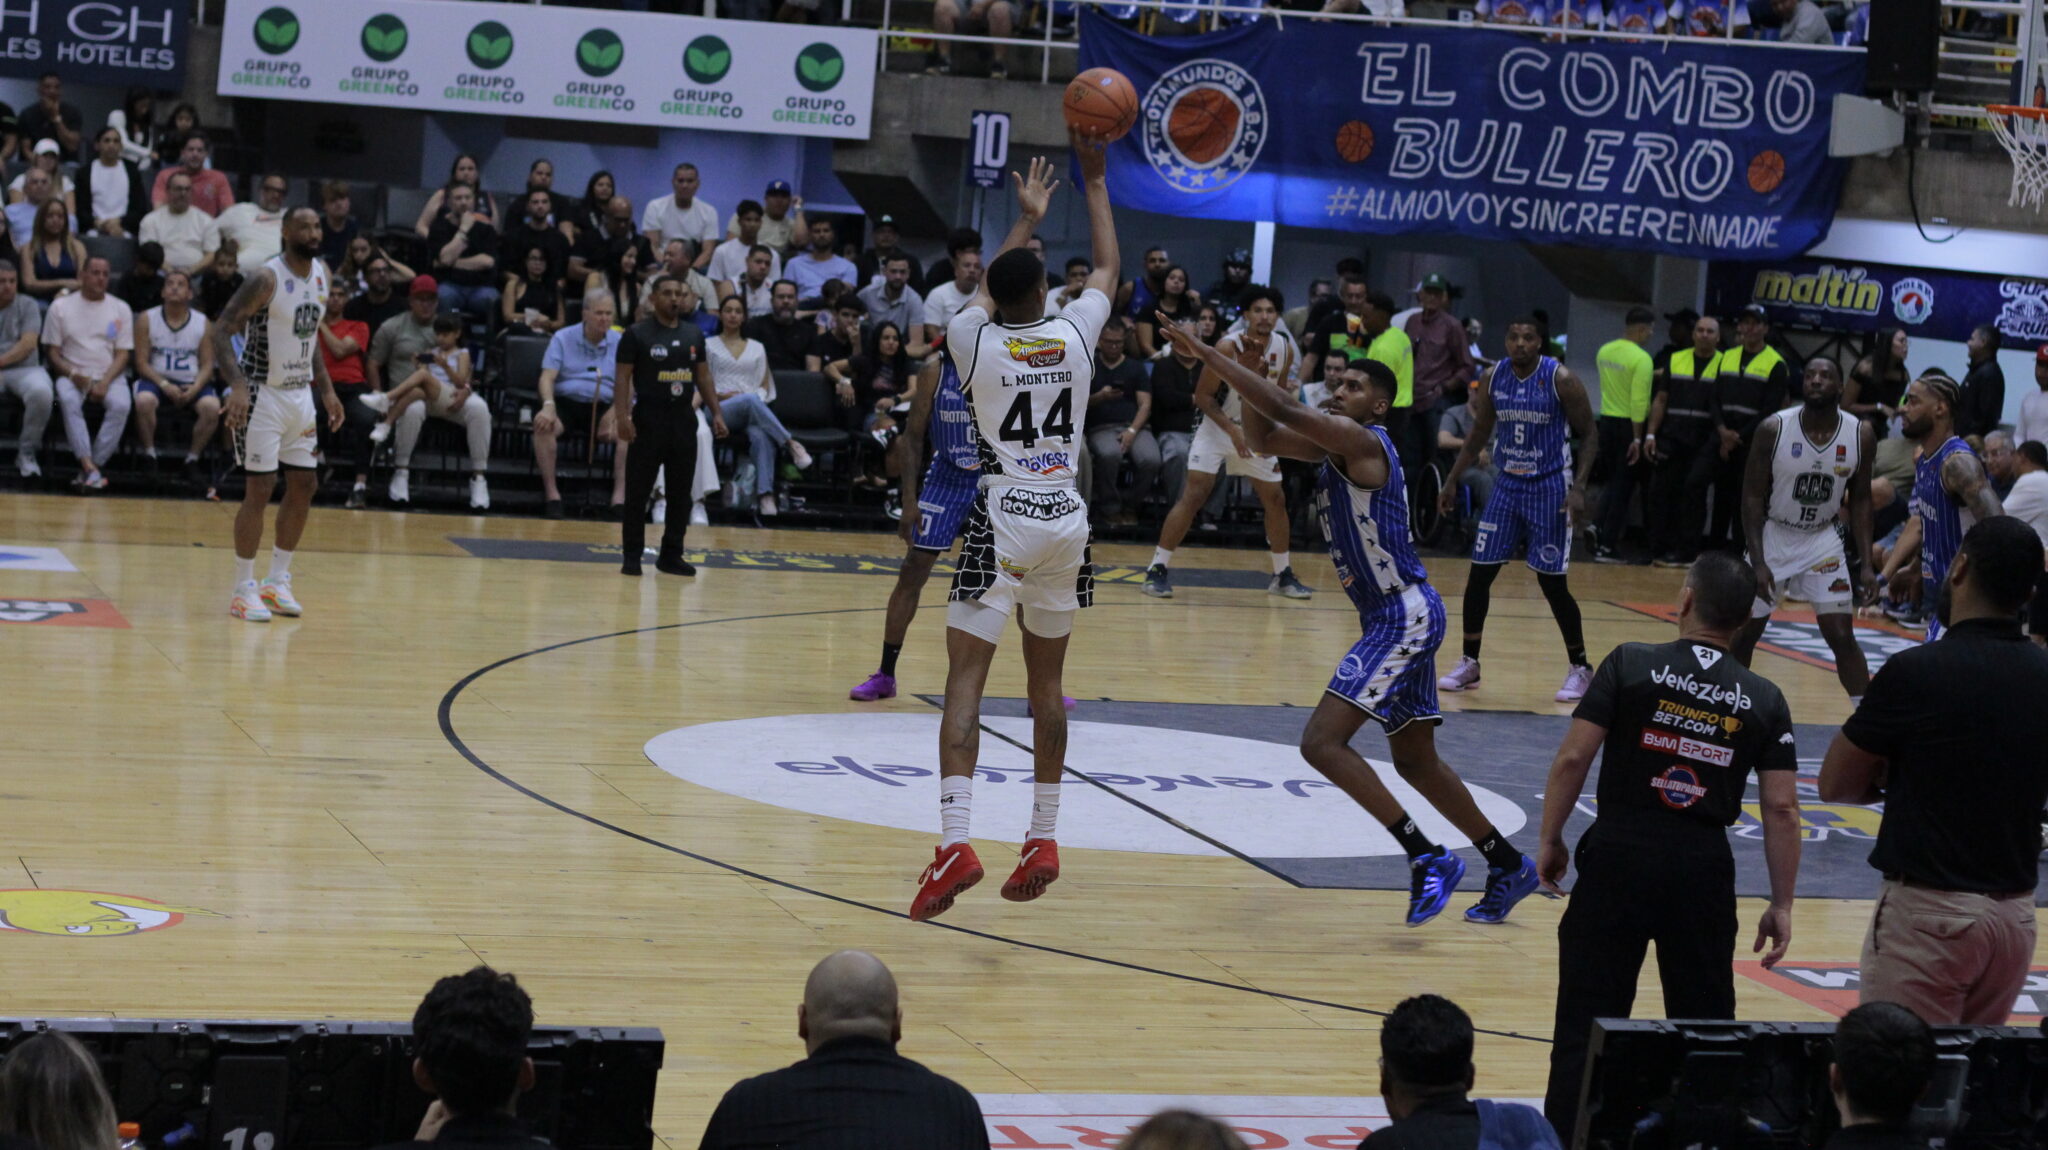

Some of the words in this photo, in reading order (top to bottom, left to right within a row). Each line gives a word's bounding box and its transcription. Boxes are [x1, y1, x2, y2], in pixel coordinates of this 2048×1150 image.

[67, 2, 173, 45] GH
[57, 42, 175, 71] HOTELES
[244, 59, 301, 74] GRUPO
[351, 66, 409, 82] GRUPO
[231, 72, 311, 89] GREENCO
[338, 79, 419, 96] GREENCO
[456, 74, 515, 89] GRUPO
[566, 82, 625, 96] GRUPO
[1357, 42, 1456, 106] EL
[1499, 46, 1815, 135] COMBO
[443, 87, 524, 104] GREENCO
[553, 94, 635, 111] GREENCO
[673, 88, 733, 104] GRUPO
[785, 96, 846, 112] GRUPO
[660, 101, 743, 118] GREENCO
[1147, 65, 1246, 148] TROTAMUNDOS
[772, 109, 856, 126] GREENCO
[972, 112, 1010, 168] 10
[1388, 117, 1734, 203] BULLERO
[1324, 185, 1782, 249] #ALMIOVOYSINCREERENNADIE
[1754, 264, 1882, 315] maltín
[301, 341, 309, 358] 11
[166, 353, 190, 370] 12
[1001, 376, 1012, 387] L.
[1015, 371, 1072, 386] MONTERO
[999, 387, 1074, 449] 44
[1514, 424, 1525, 445] 5
[1016, 452, 1070, 471] navesa
[1007, 487, 1069, 505] APUESTAS
[1793, 473, 1834, 502] CCS
[1001, 497, 1080, 520] ROYAL.COM
[1800, 507, 1817, 522] 15
[1475, 533, 1488, 552] 5
[1700, 649, 1714, 661] 21
[1658, 699, 1720, 724] TRIUNFO
[1652, 710, 1718, 736] BET.COM
[1679, 742, 1730, 763] SPORT
